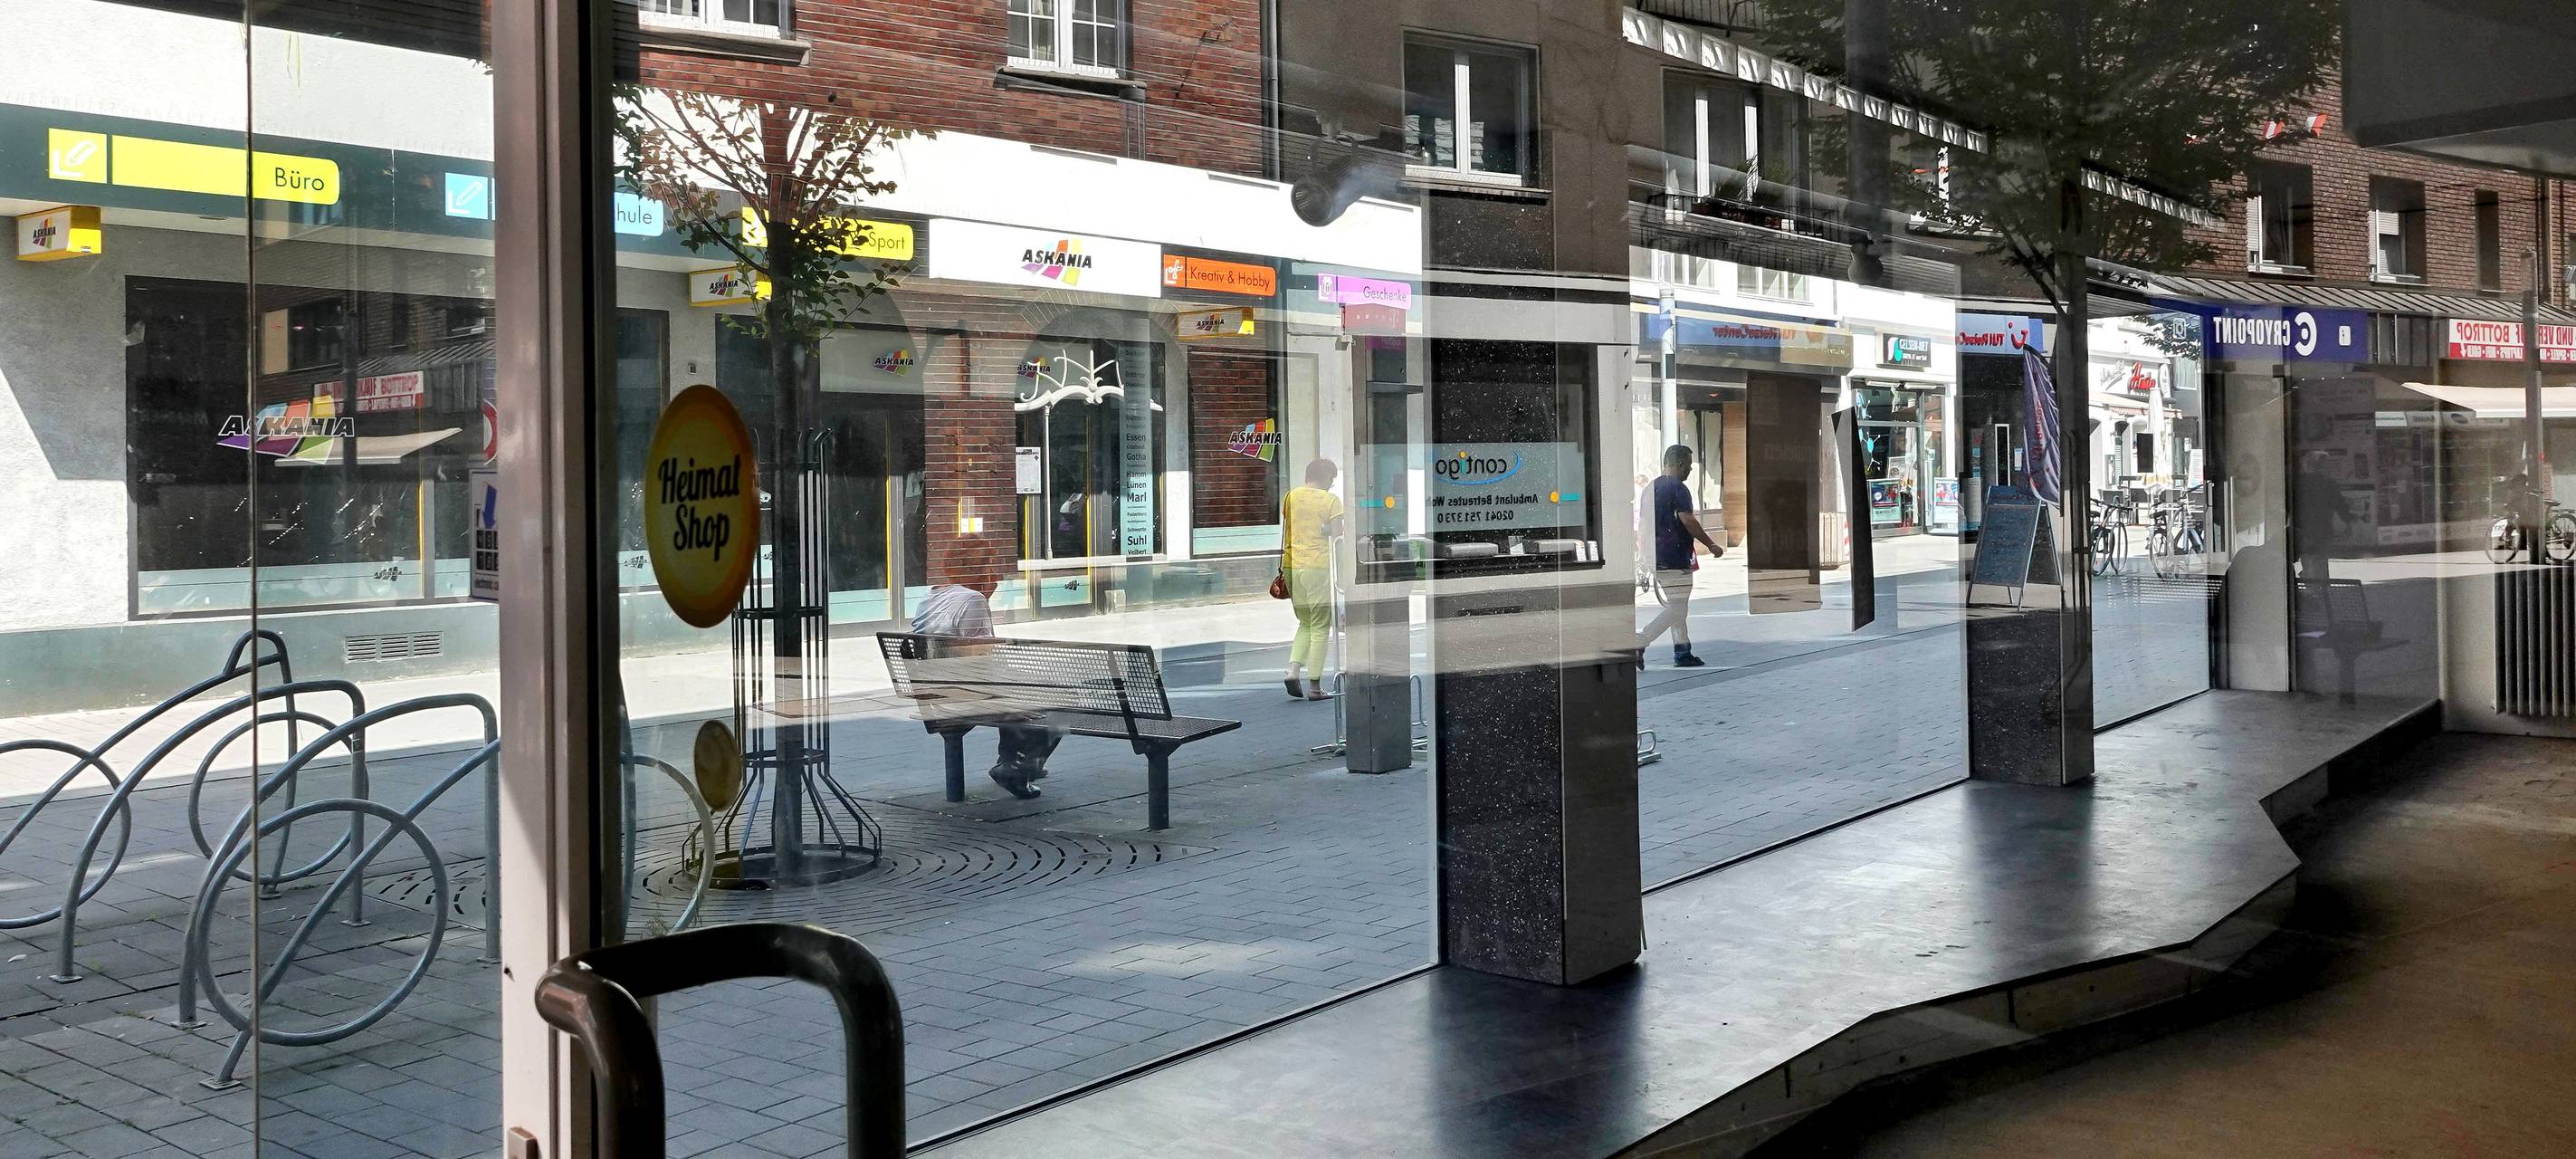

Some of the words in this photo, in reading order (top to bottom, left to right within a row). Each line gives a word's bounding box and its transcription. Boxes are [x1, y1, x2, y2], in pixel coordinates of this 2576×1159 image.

[275, 167, 324, 191] Büro
[616, 202, 653, 225] hule
[868, 231, 906, 253] Sport
[1021, 248, 1092, 269] ASKANIA
[709, 280, 739, 291] ASKANIA
[1189, 266, 1225, 283] Kreativ
[1227, 272, 1236, 284] &
[1237, 273, 1271, 292] Hobby
[1362, 285, 1407, 302] Geschenke
[1196, 318, 1225, 329] ASKANIA
[874, 357, 914, 367] ASKANIA
[217, 415, 356, 437] ASKANIA
[1126, 433, 1147, 441] Essen
[1227, 431, 1283, 445] ASKANIA
[1126, 453, 1147, 461] Gotha
[1126, 470, 1147, 478] Hamm
[1126, 492, 1147, 503] Marl
[673, 503, 730, 562] Shop
[1127, 534, 1147, 546] Suhl
